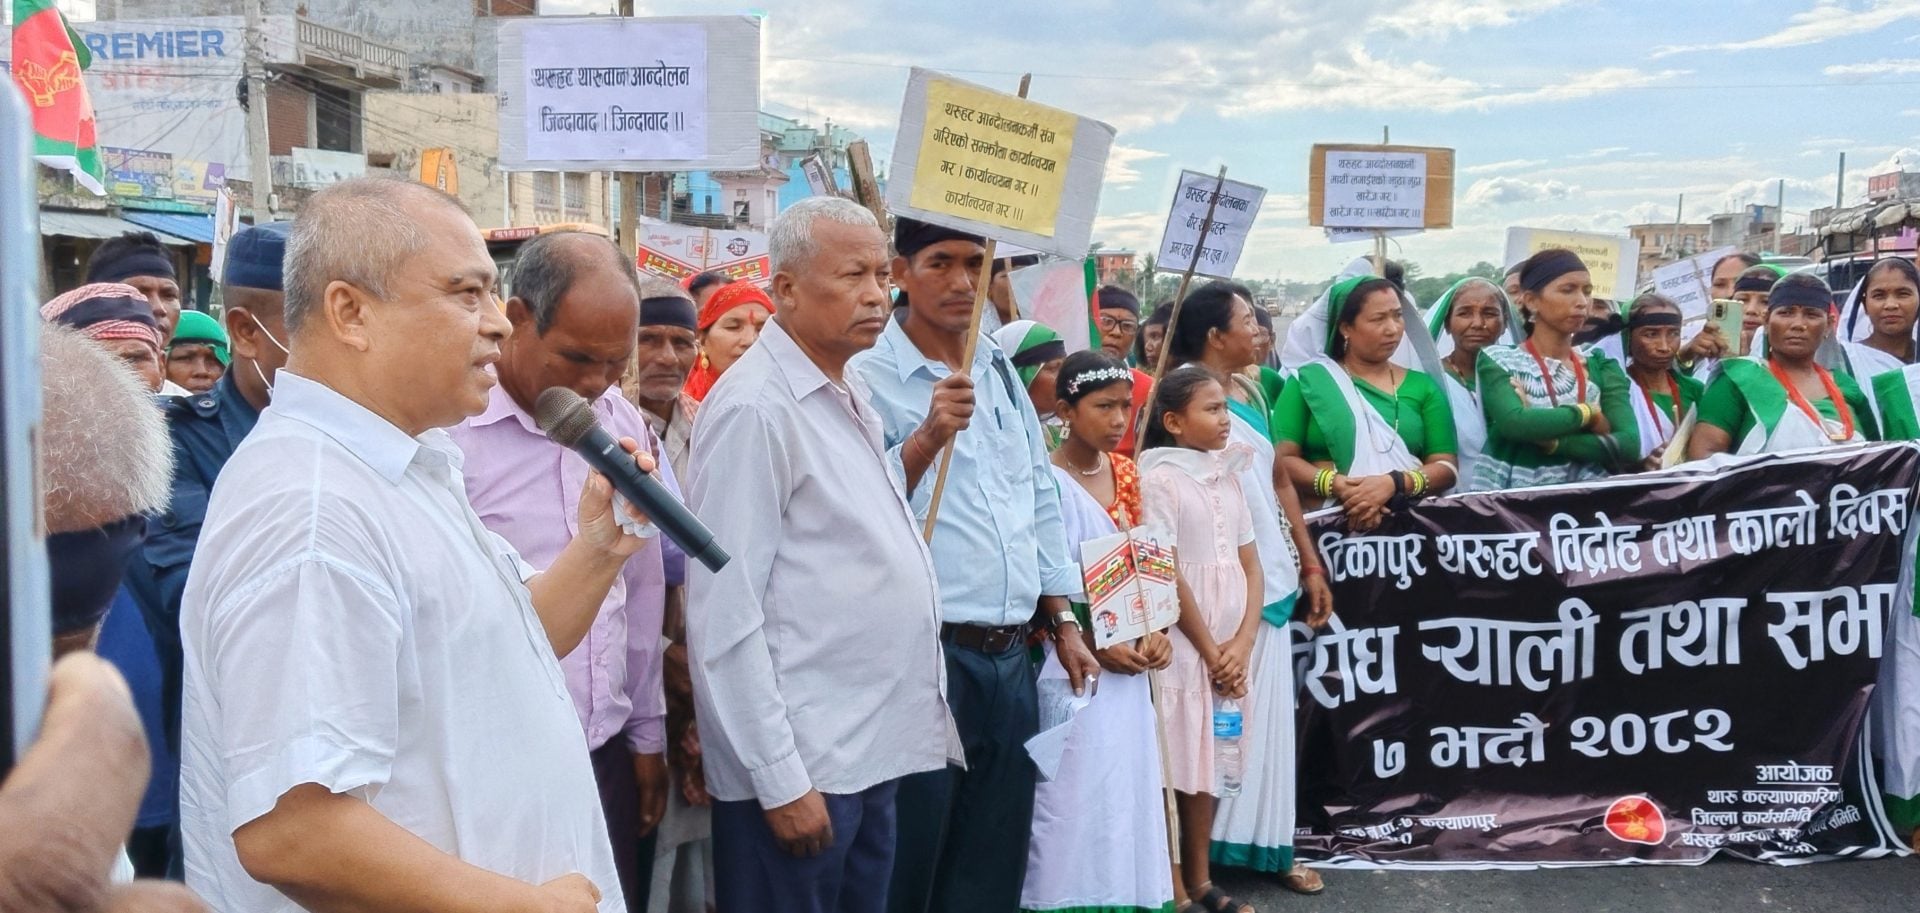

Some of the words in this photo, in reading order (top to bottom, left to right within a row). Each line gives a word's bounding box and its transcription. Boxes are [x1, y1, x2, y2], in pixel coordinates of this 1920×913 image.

[84, 30, 225, 59] REMIER
[540, 106, 599, 133] जिन्दावाद
[610, 105, 668, 133] जिन्दावाद
[1550, 512, 1642, 577] विद्रोह
[1652, 514, 1718, 566] तथा
[1726, 489, 1820, 556] कालो
[1827, 483, 1910, 539] दिवस
[1619, 598, 1748, 675] तथा
[1766, 583, 1898, 671] सभा
[1373, 739, 1405, 778] ७
[1430, 712, 1550, 768] भदौ
[1570, 709, 1734, 757] २०८२
[1755, 760, 1834, 782] आयोजक
[1691, 808, 1738, 826] जिल्ला
